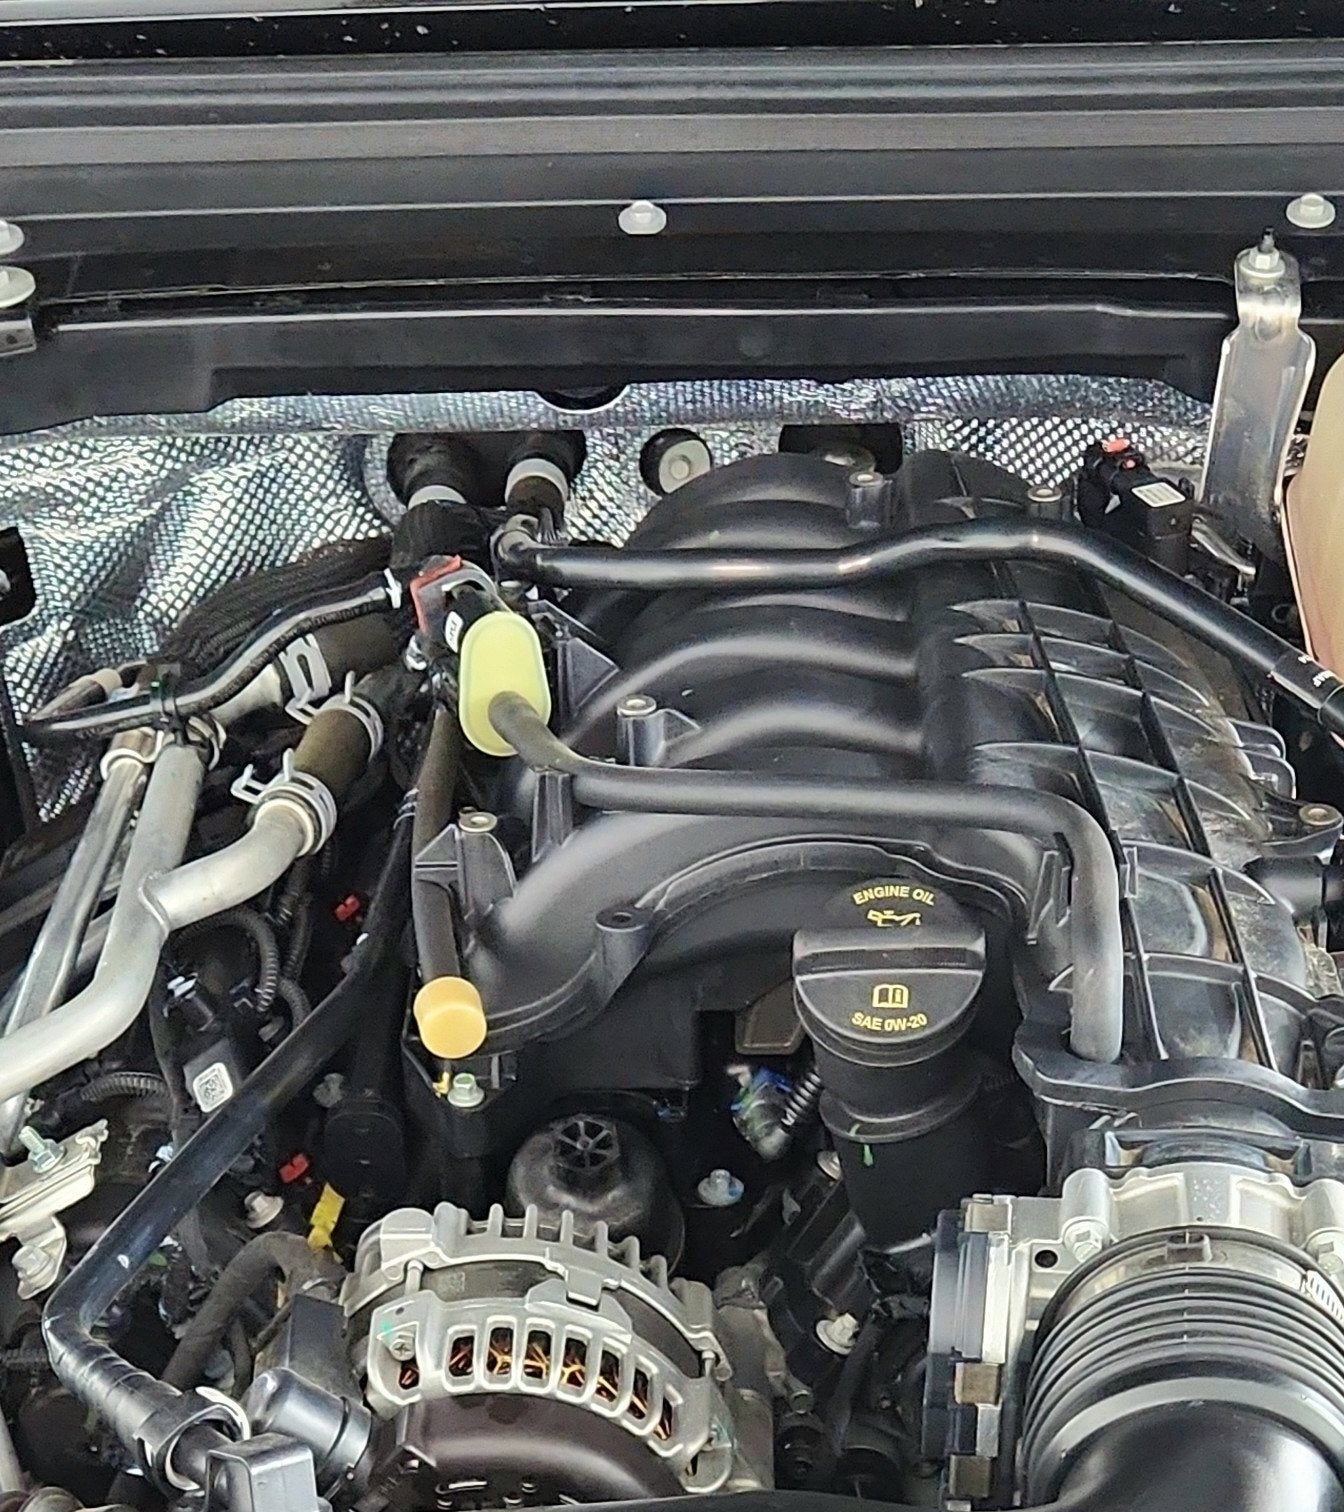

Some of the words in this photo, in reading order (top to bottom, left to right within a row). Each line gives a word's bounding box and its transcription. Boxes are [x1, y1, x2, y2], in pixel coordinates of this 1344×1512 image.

[852, 886, 910, 905] ENGINE
[912, 888, 936, 906] OIL
[851, 1012, 883, 1031] SAE
[884, 1013, 928, 1032] 0W-20
